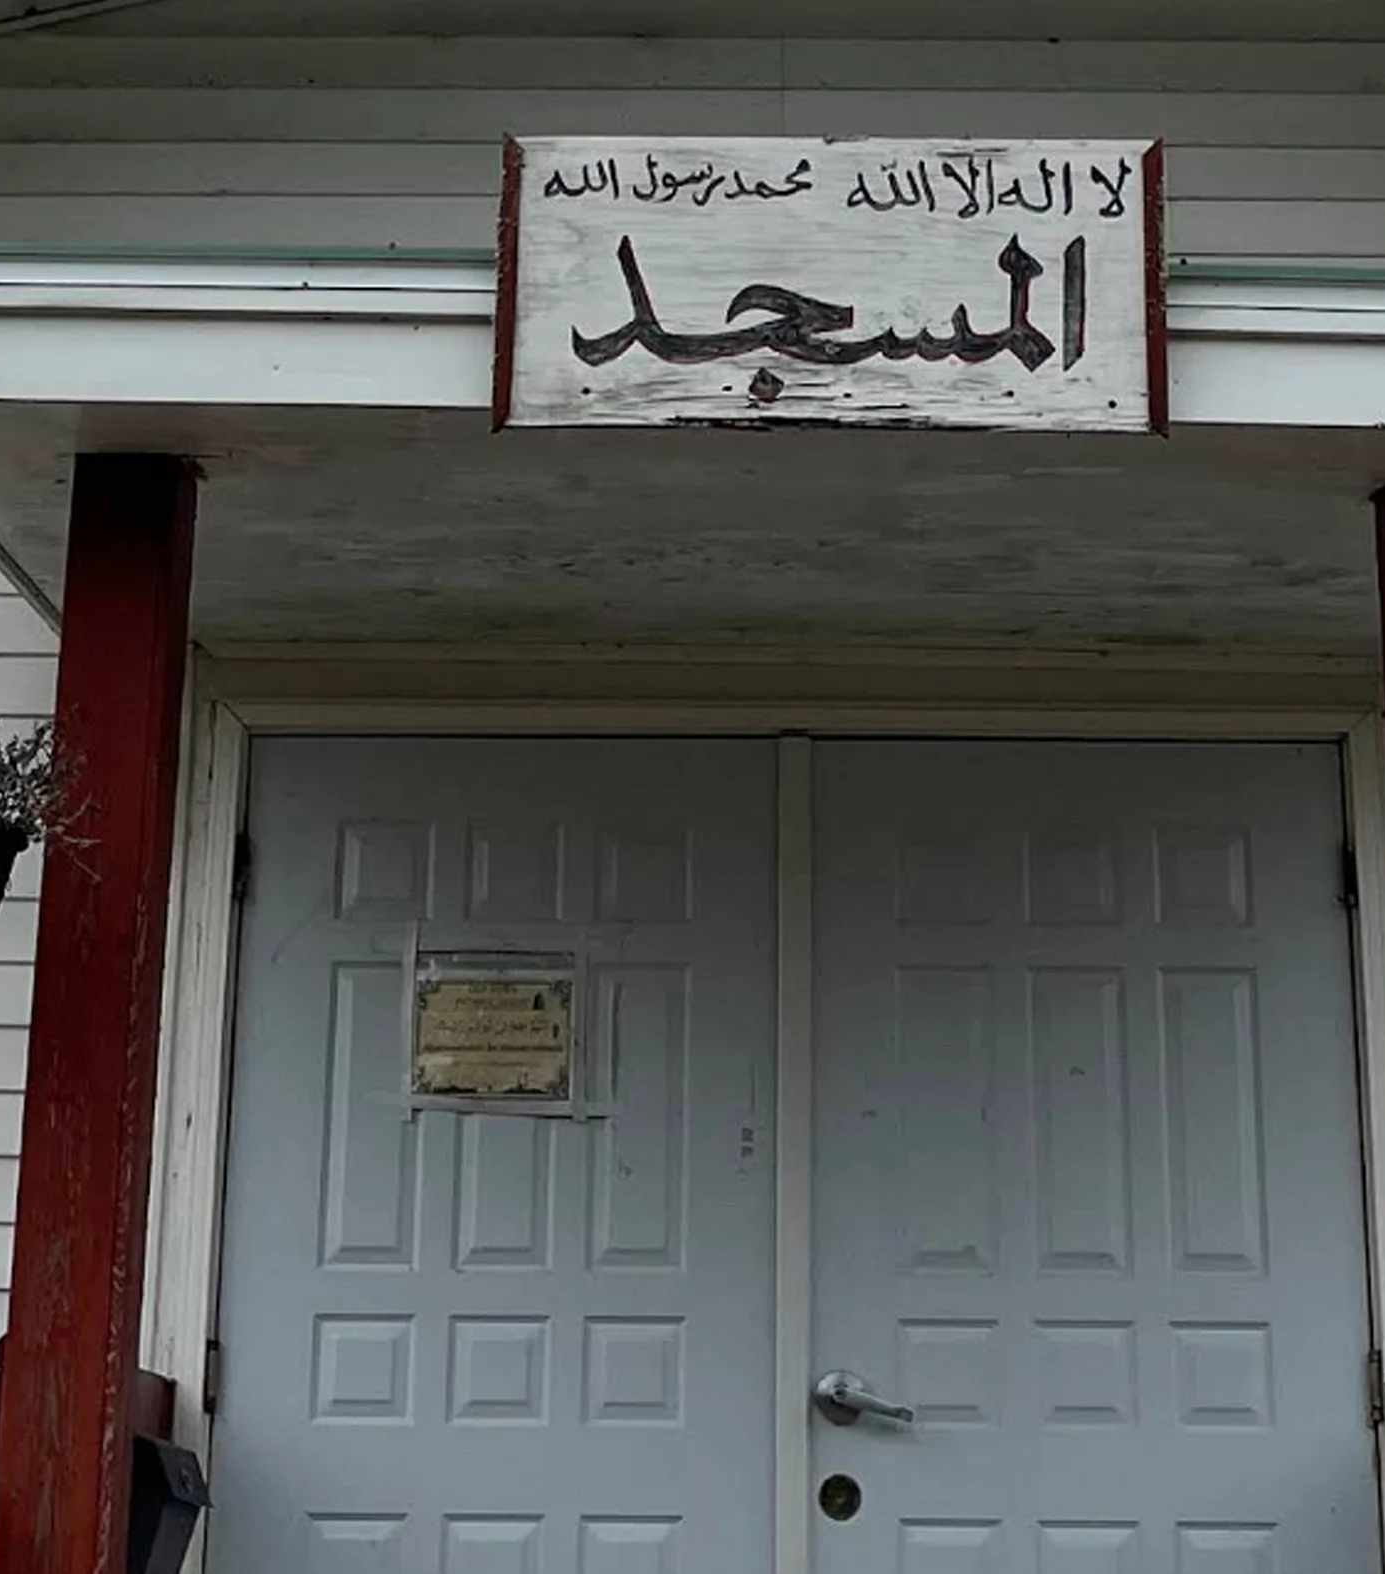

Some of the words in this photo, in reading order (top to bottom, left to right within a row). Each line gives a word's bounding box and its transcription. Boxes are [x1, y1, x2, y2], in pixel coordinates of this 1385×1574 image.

[543, 158, 620, 200] الله
[633, 153, 726, 206] رسول
[724, 158, 813, 200] محمد
[846, 158, 935, 213] الله
[1090, 156, 1132, 217] لا
[571, 233, 1085, 402] المسجد
